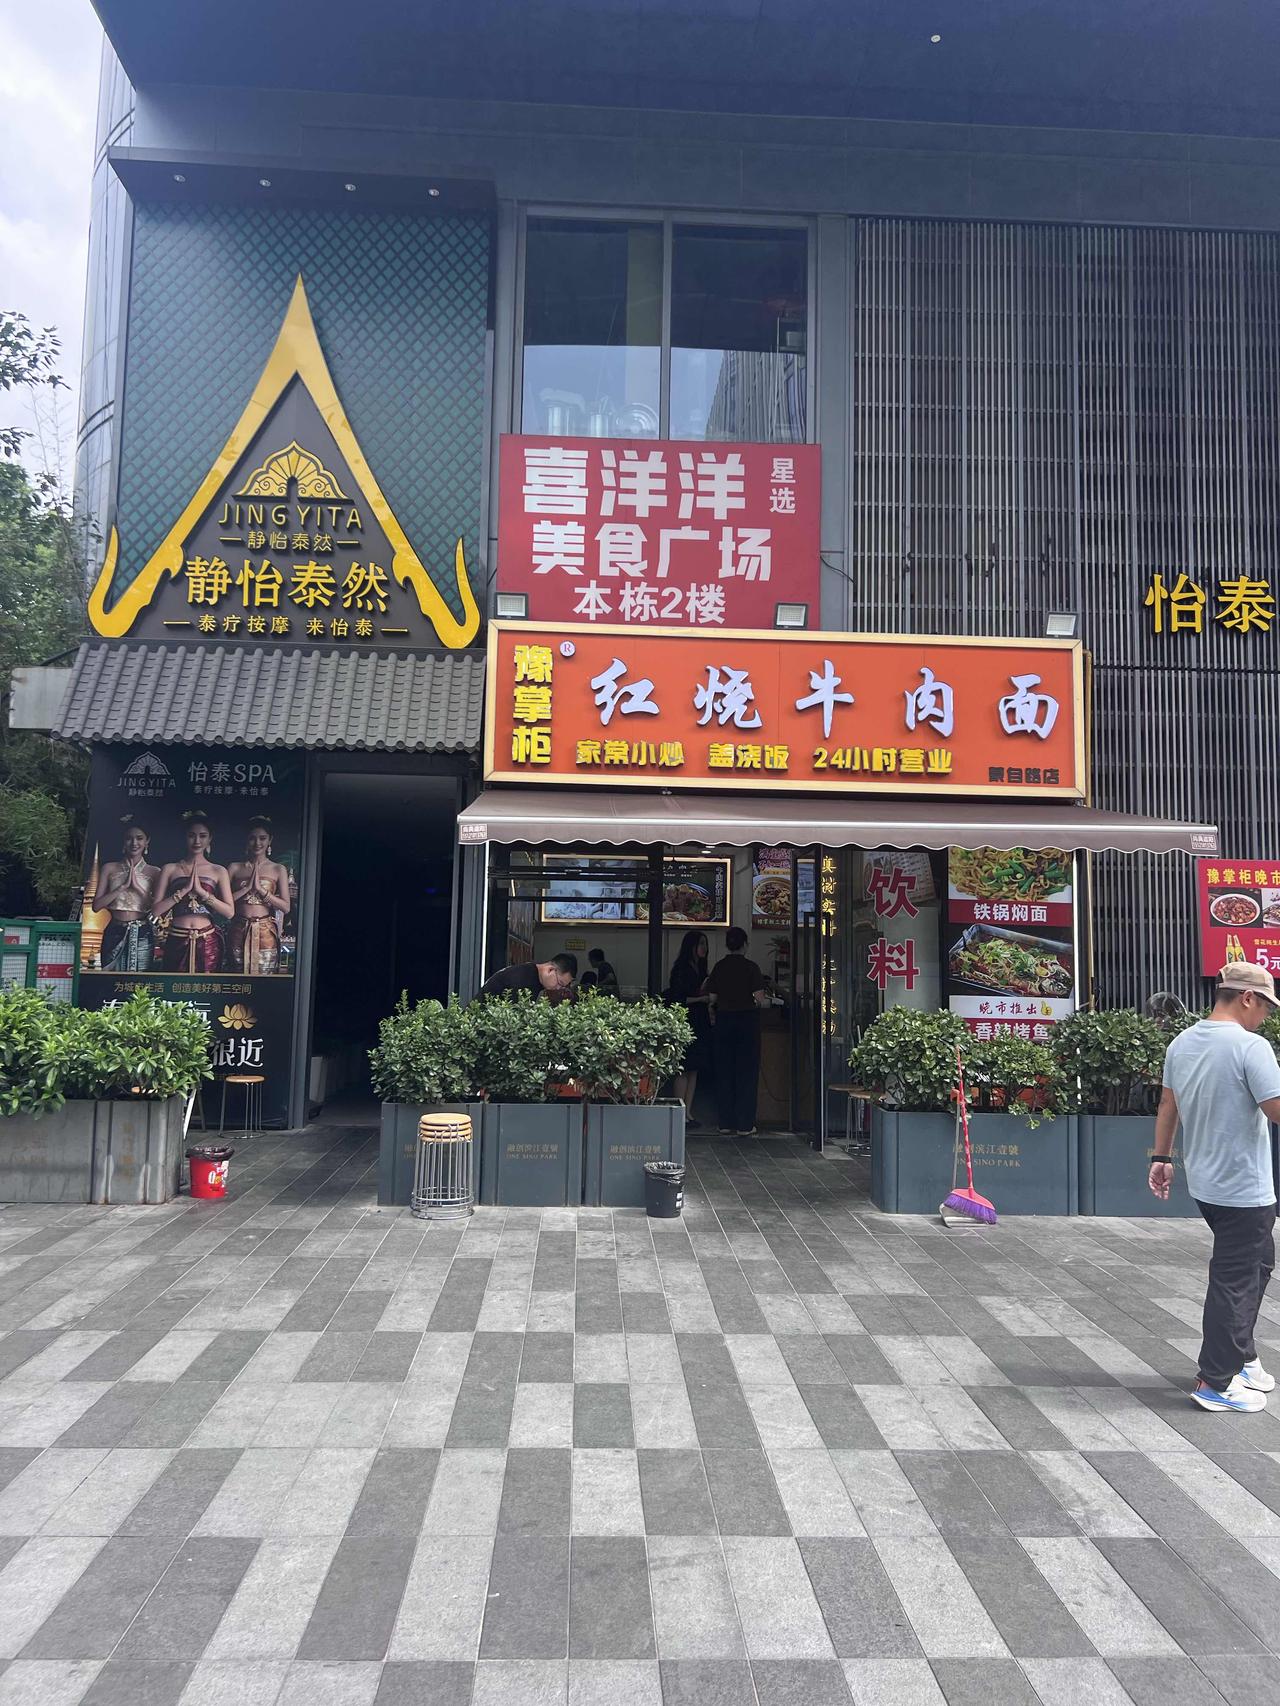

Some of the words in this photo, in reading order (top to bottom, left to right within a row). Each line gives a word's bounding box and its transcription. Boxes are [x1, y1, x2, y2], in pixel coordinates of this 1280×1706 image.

[522, 447, 746, 520] 喜洋洋
[769, 457, 797, 515] 星选
[247, 530, 333, 551] 静怡泰然
[531, 520, 772, 582] 美食广场
[185, 555, 389, 612] 静怡泰然
[573, 580, 727, 624] 本栋2楼
[1143, 573, 1276, 634] 怡泰
[198, 613, 290, 635] 泰疗按摩
[306, 618, 374, 637] 来怡泰
[512, 644, 553, 765] 豫掌柜
[590, 657, 1060, 741] 红烧牛肉面
[188, 761, 278, 784] 怡泰SPA
[576, 740, 686, 768] 家常小炒
[708, 743, 790, 771] 盖浇饭
[813, 747, 953, 774] 24小时营业
[867, 867, 921, 992] 饮料
[973, 902, 1049, 923] 铁锅焖面
[172, 982, 252, 995] 创造美好第三空间
[979, 1001, 1037, 1015] 晚市推出
